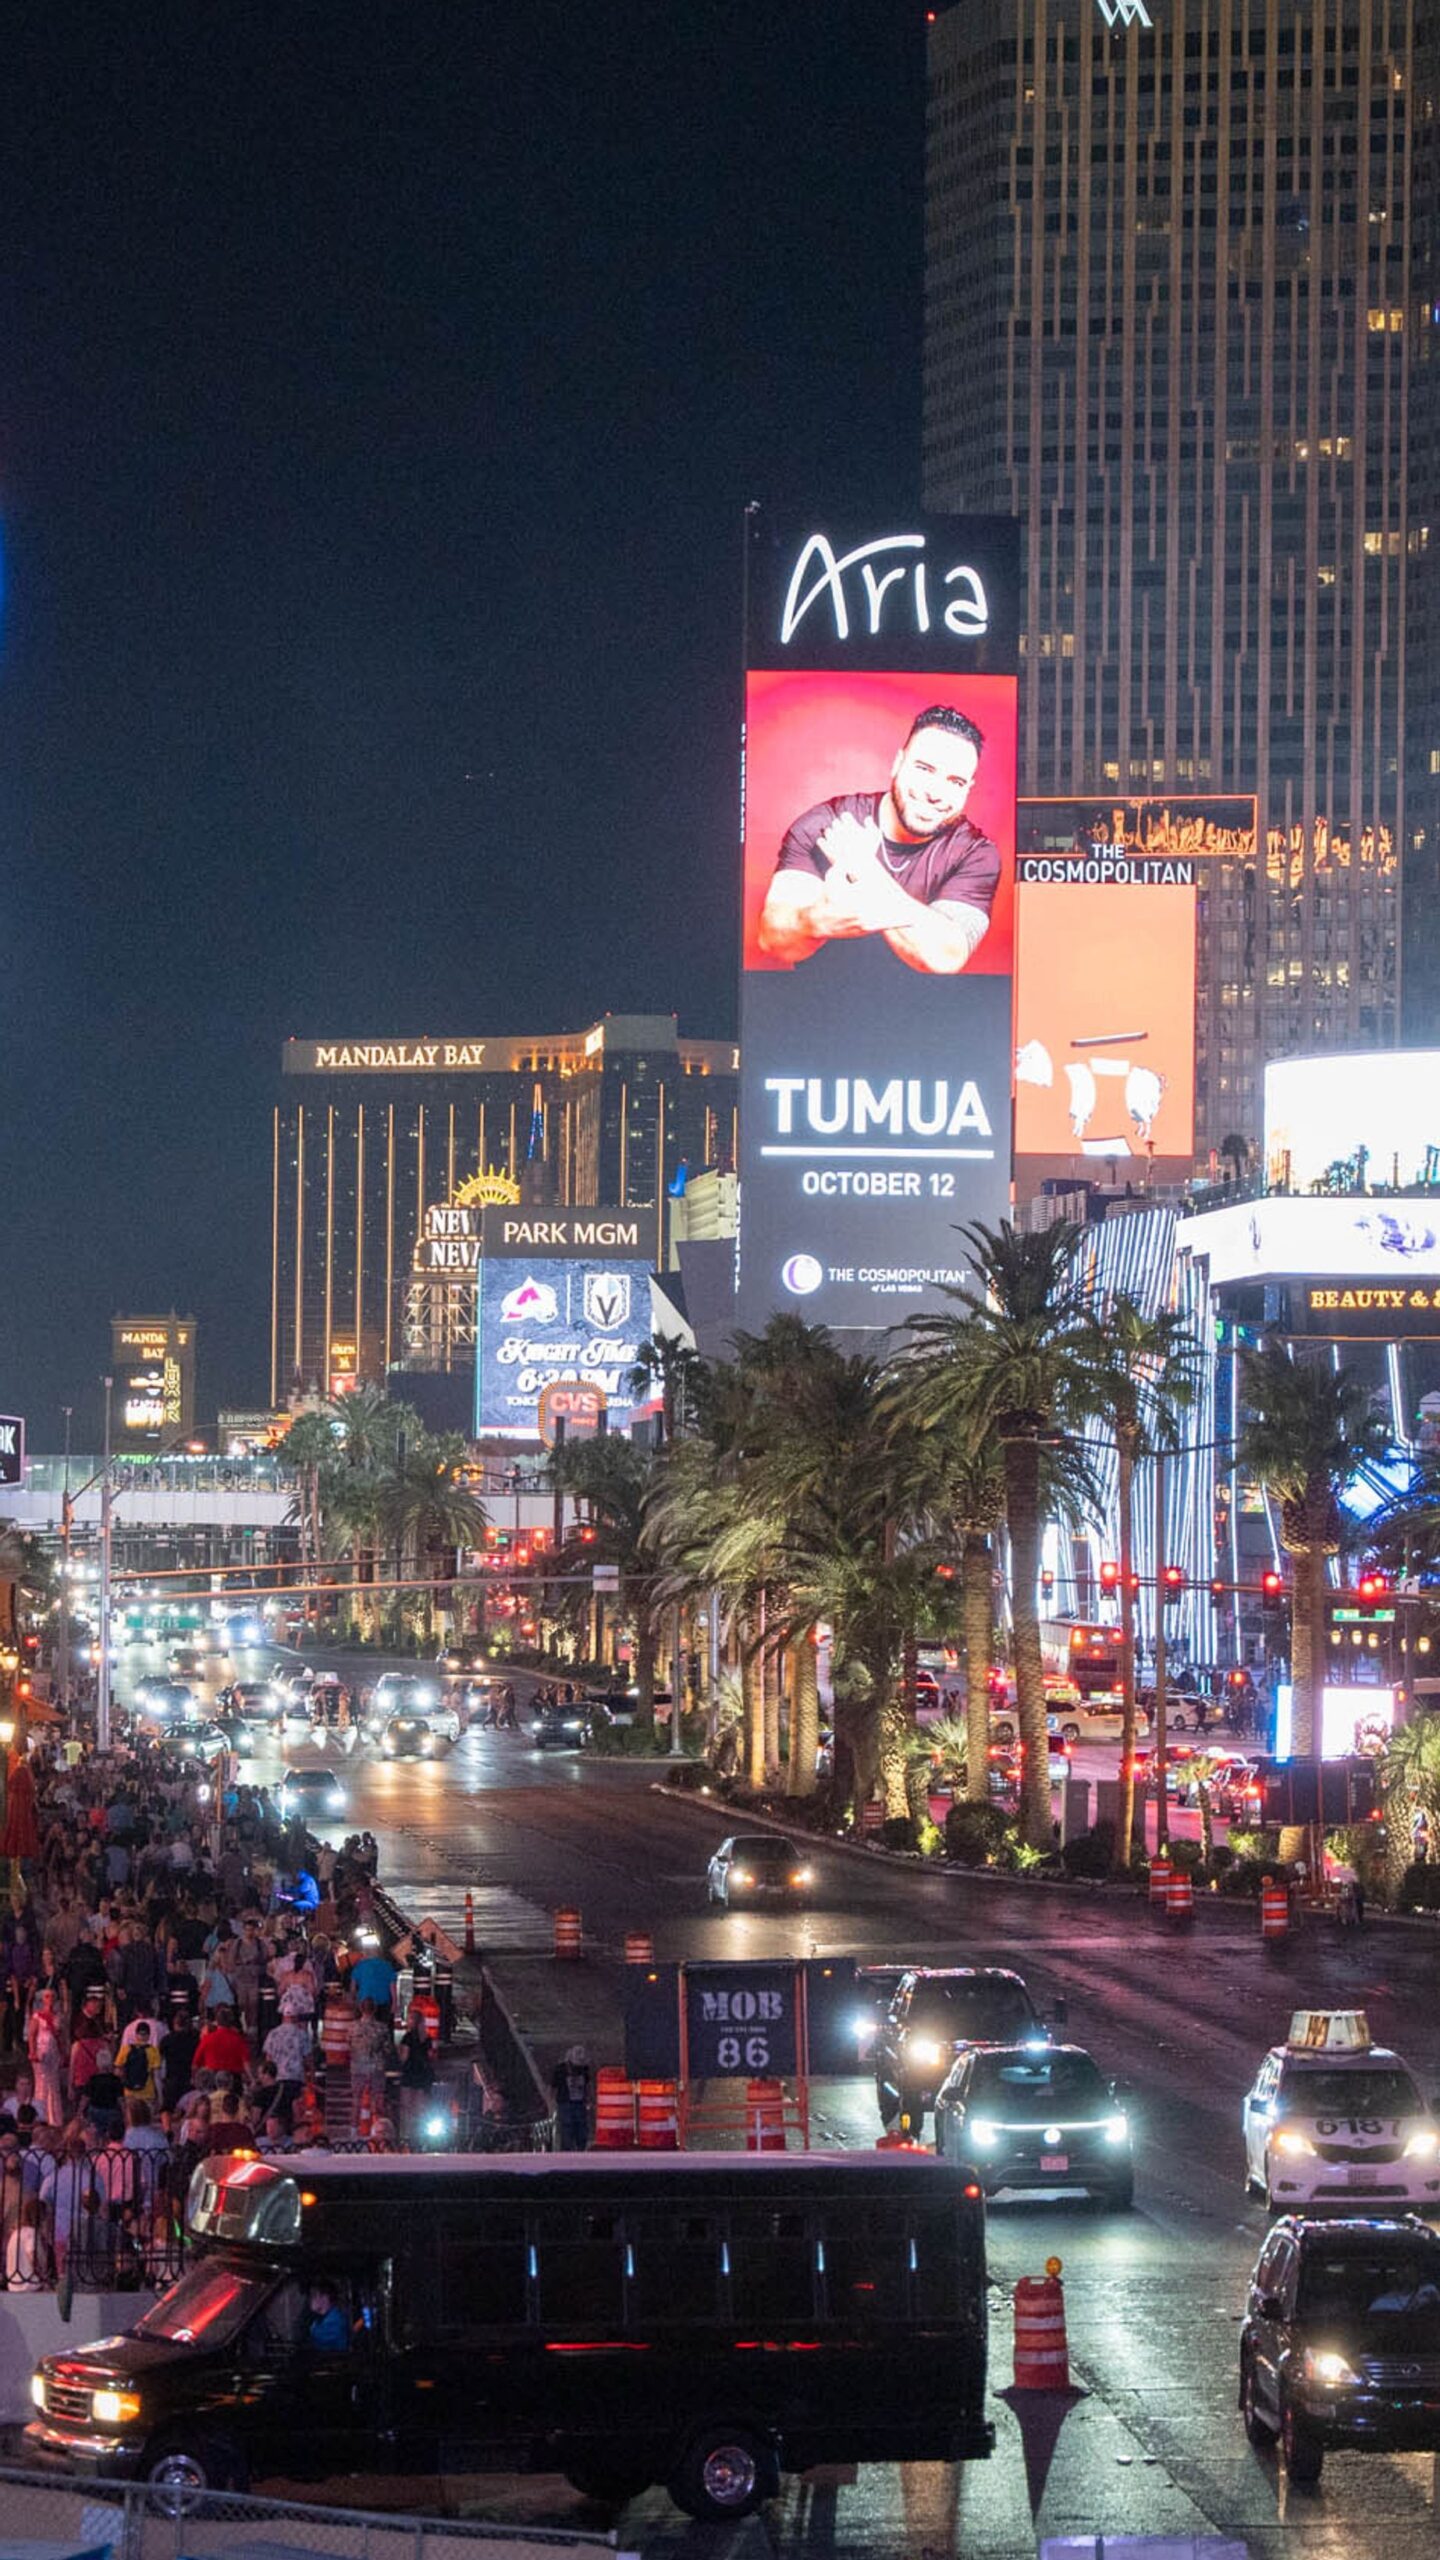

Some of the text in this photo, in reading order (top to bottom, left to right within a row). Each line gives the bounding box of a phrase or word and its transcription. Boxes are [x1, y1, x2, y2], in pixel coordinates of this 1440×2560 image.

[780, 534, 989, 644] Aria
[1091, 844, 1126, 860] THE
[1023, 860, 1193, 884] COSMOPOLITAN
[315, 1045, 486, 1067] MANDALAY BAY
[764, 1078, 993, 1136] TUMUA
[802, 1171, 955, 1197] OCTOBER 12
[503, 1222, 638, 1245] PARK MGM
[828, 1267, 854, 1282] THE
[1310, 1290, 1406, 1308] BEAUTY
[1409, 1289, 1430, 1308] &
[142, 1347, 165, 1359] BAY
[550, 1391, 599, 1412] CVS
[702, 1991, 784, 2021] MOB
[717, 2037, 769, 2069] 86
